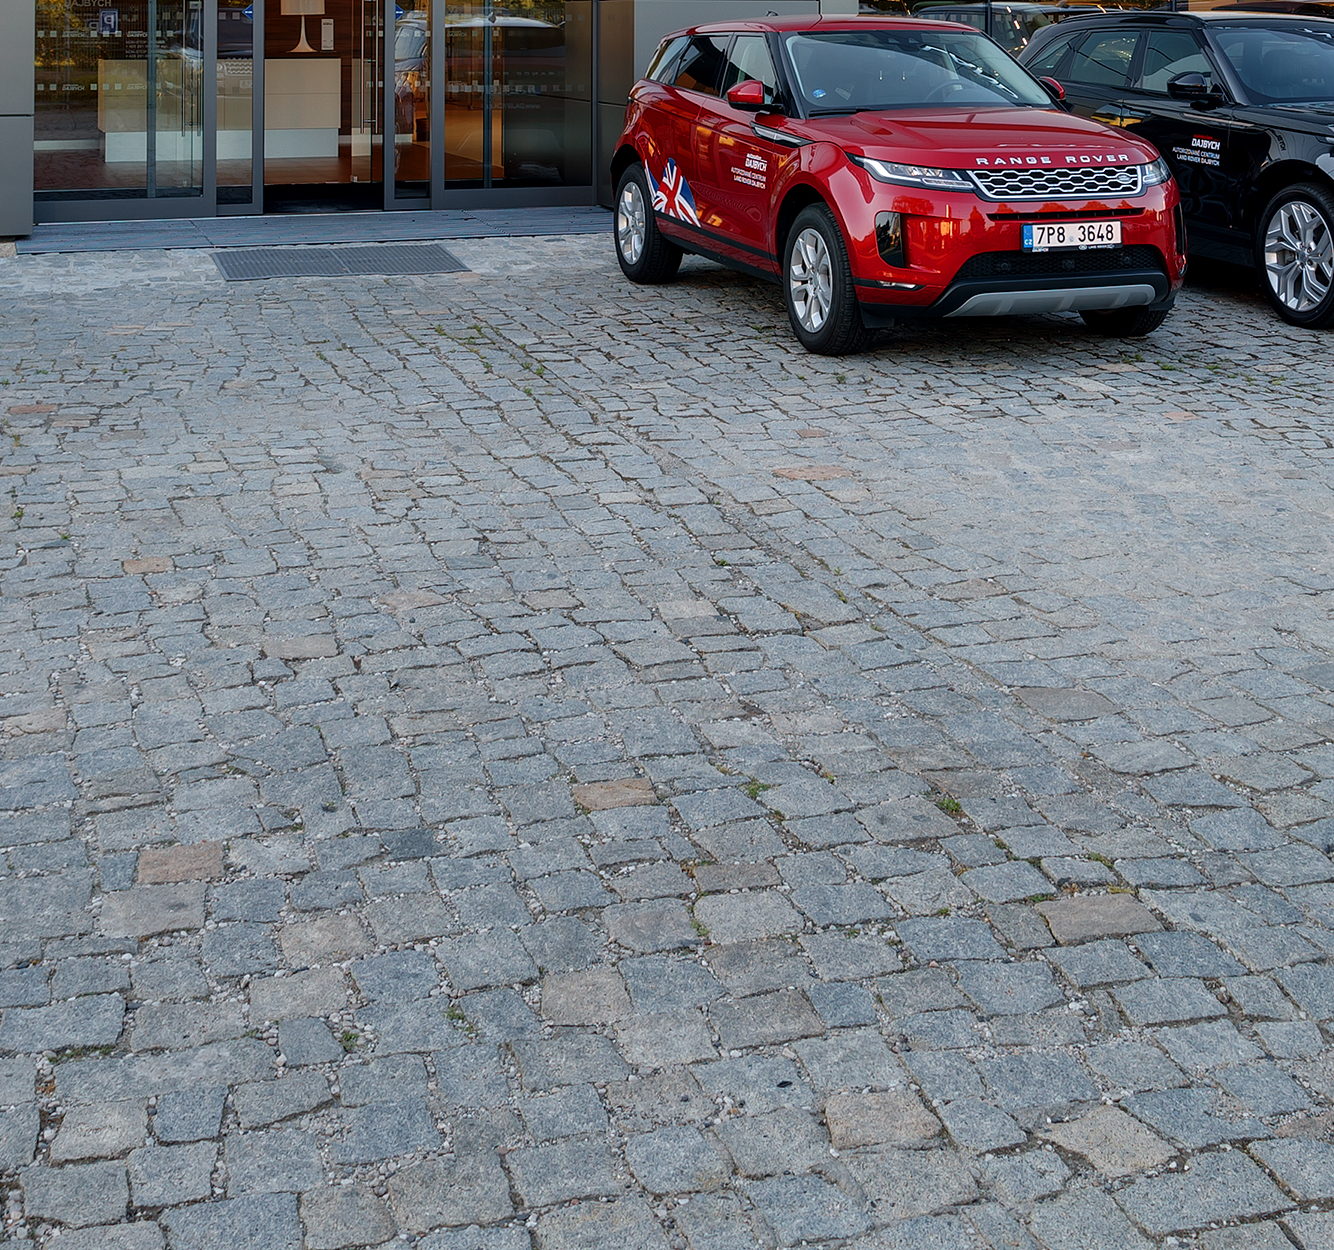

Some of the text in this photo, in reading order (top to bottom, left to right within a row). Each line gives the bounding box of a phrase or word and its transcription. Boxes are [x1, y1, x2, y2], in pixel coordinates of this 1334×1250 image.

[65, 0, 112, 8] DAJBYCH
[1191, 138, 1221, 150] DAJBYCH
[745, 158, 767, 172] DAJBYCH
[975, 154, 1129, 165] RANGE ROVER
[1037, 224, 1114, 244] 7P8 3648
